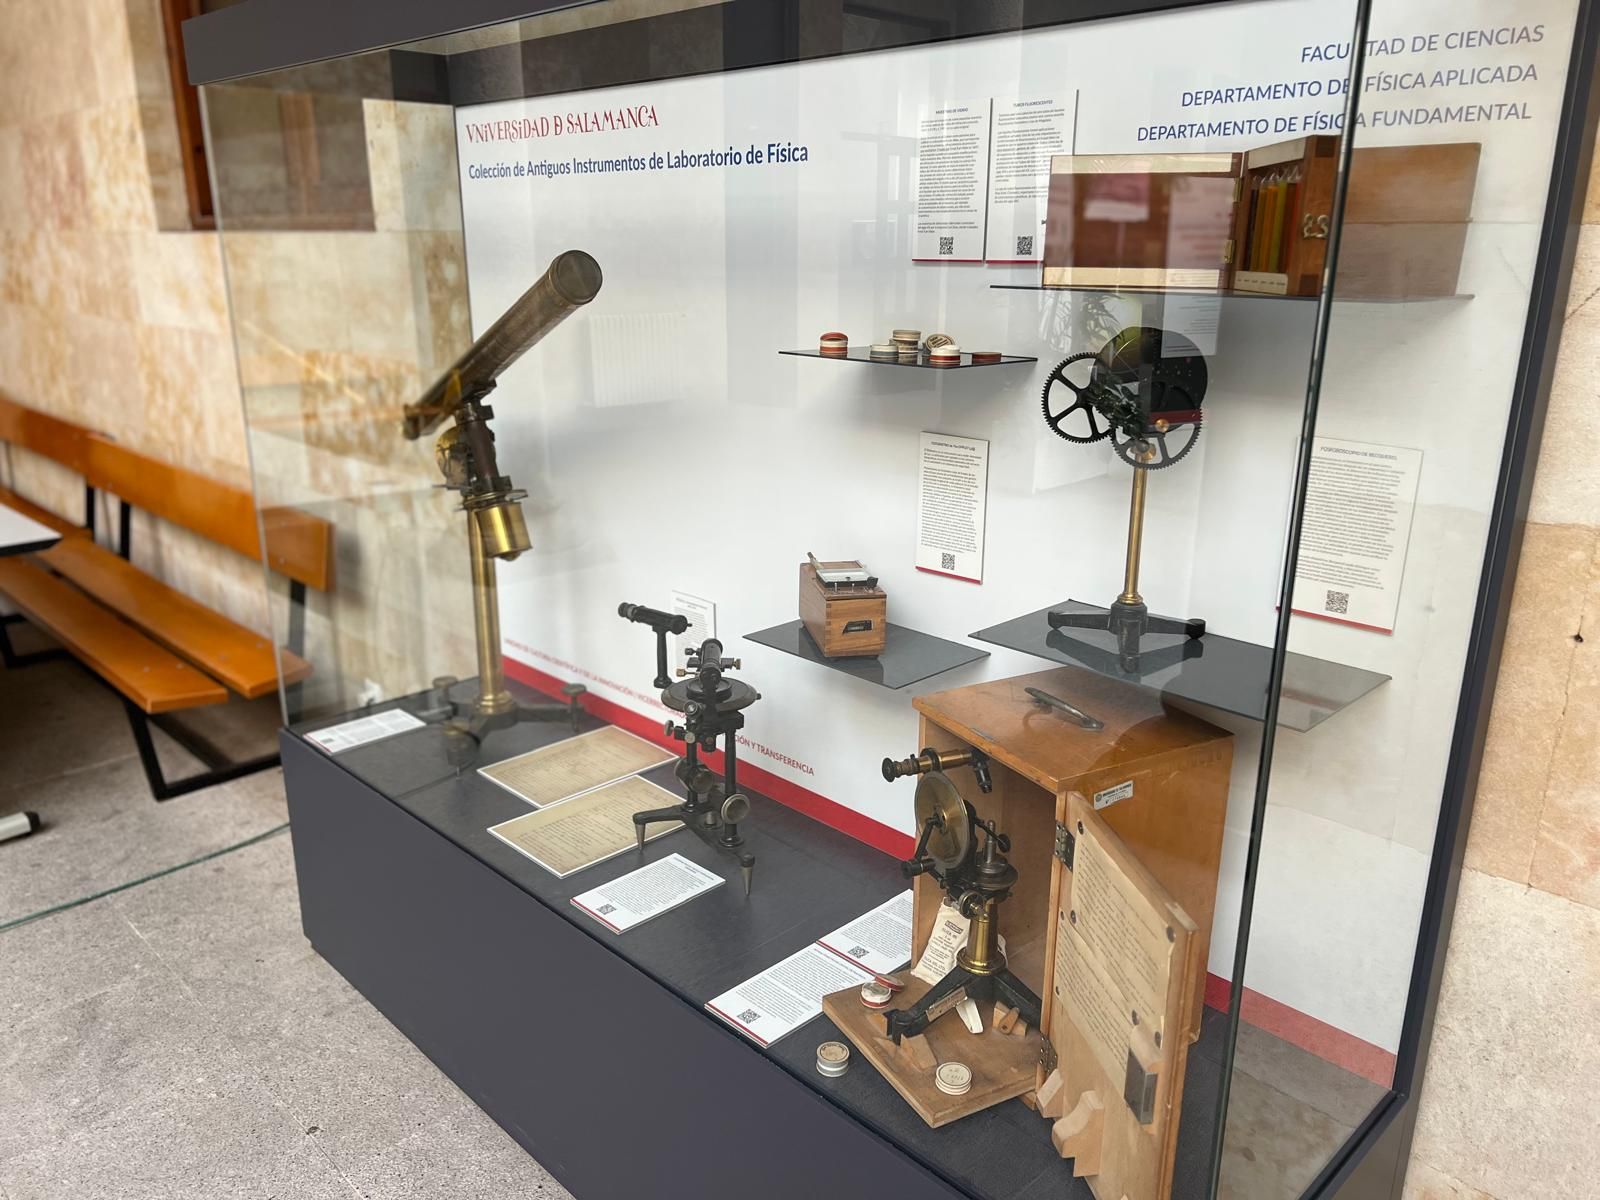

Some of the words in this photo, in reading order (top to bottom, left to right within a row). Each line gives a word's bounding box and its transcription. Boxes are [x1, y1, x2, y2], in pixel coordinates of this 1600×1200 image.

[1301, 38, 1405, 62] FACUTAD
[1411, 34, 1440, 52] DE
[1445, 25, 1544, 49] CIENCIAS
[1182, 80, 1322, 106] DEPARTAMENTO
[1328, 78, 1350, 95] DE
[1364, 71, 1426, 92] FÍSICA
[1430, 64, 1538, 87] APLICADA
[567, 105, 659, 134] SALAMANCA
[1138, 119, 1269, 140] DEPARTAMENTO
[1274, 116, 1298, 132] DE
[1372, 102, 1532, 127] FUNDAMENTAL
[468, 163, 511, 179] Colección
[514, 162, 525, 176] de
[527, 159, 571, 178] Antiguos
[573, 158, 646, 174] Instrumentos
[650, 152, 664, 170] de
[667, 146, 742, 169] Laboratorio
[746, 144, 763, 164] de
[768, 142, 808, 163] Física
[752, 740, 756, 749] Y
[758, 744, 814, 776] TRANSFERENCIA
